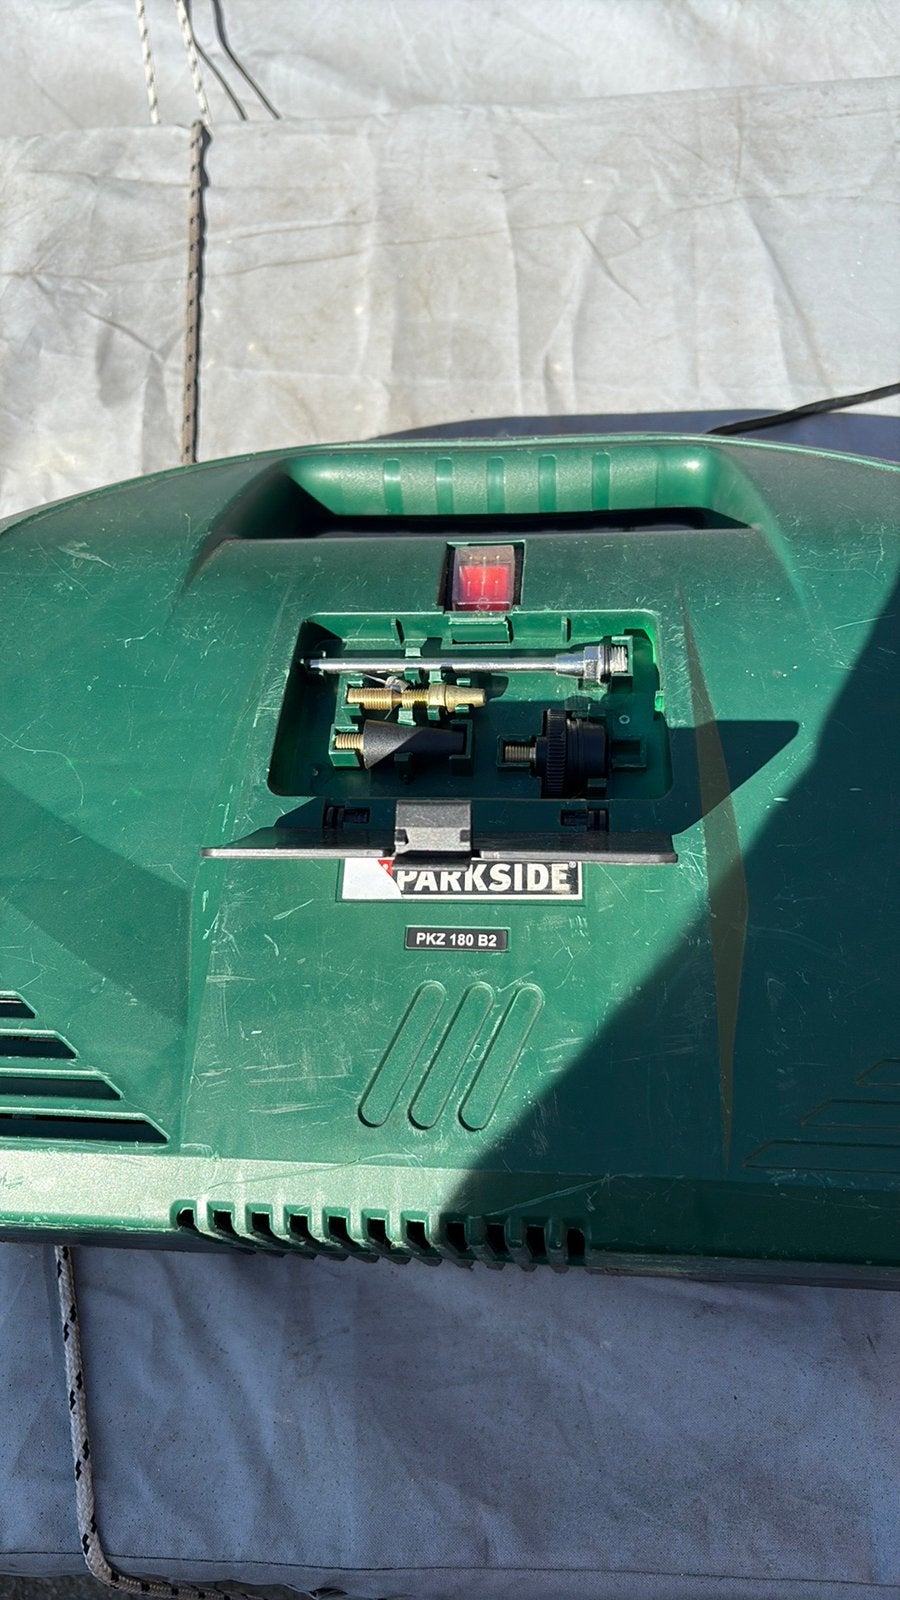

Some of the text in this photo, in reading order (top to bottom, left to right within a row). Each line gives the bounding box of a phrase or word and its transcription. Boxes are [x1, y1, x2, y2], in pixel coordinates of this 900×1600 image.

[397, 862, 570, 892] PARKSIDE
[416, 933, 497, 948] PKZ 180 B2
